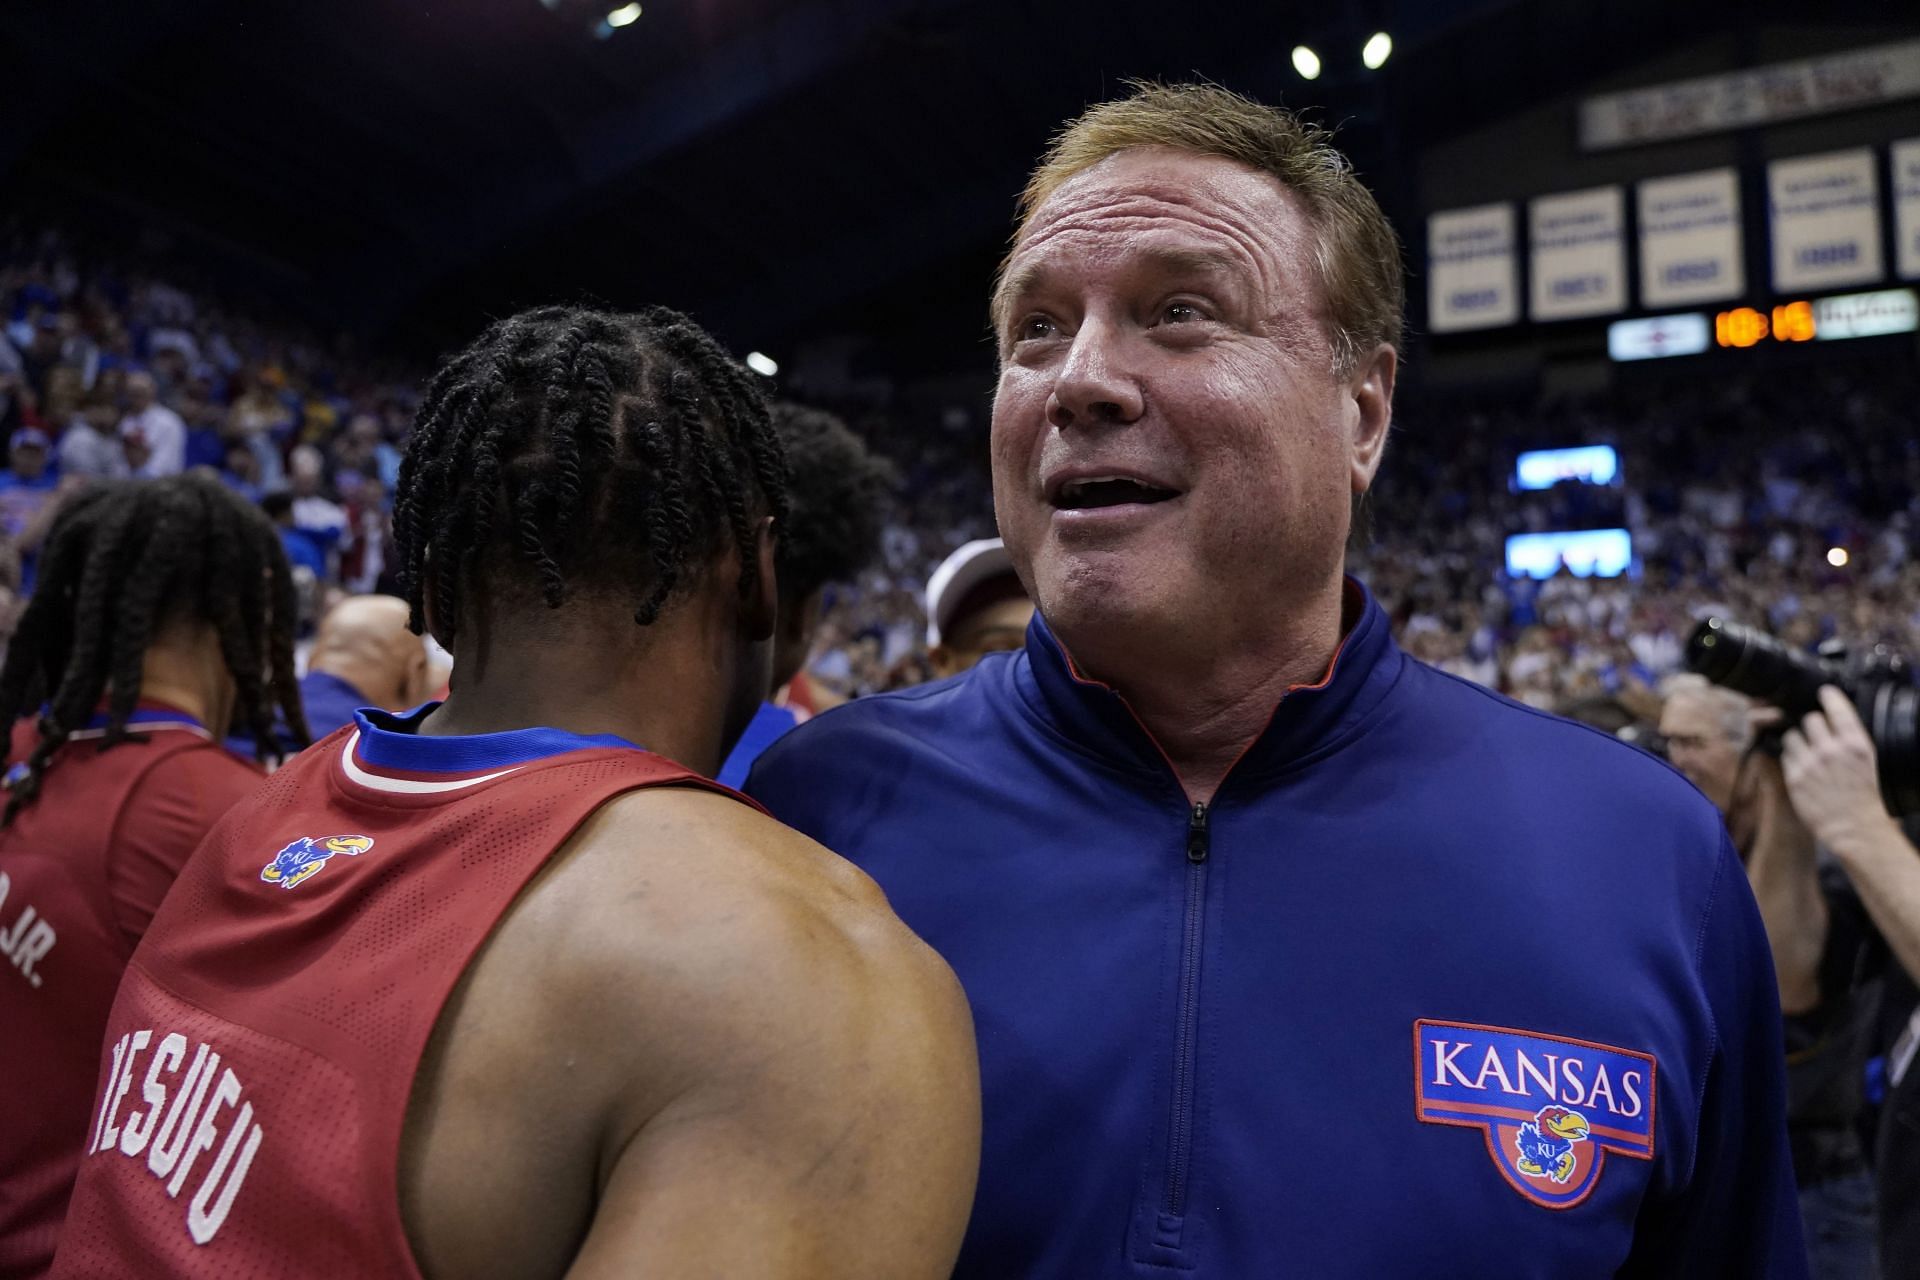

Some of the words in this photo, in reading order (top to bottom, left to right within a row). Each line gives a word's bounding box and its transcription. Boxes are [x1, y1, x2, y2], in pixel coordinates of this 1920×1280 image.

[0, 904, 57, 988] JR.
[1429, 1039, 1642, 1118] KANSAS
[89, 1029, 264, 1246] YESUFU
[1537, 1142, 1555, 1159] KU
